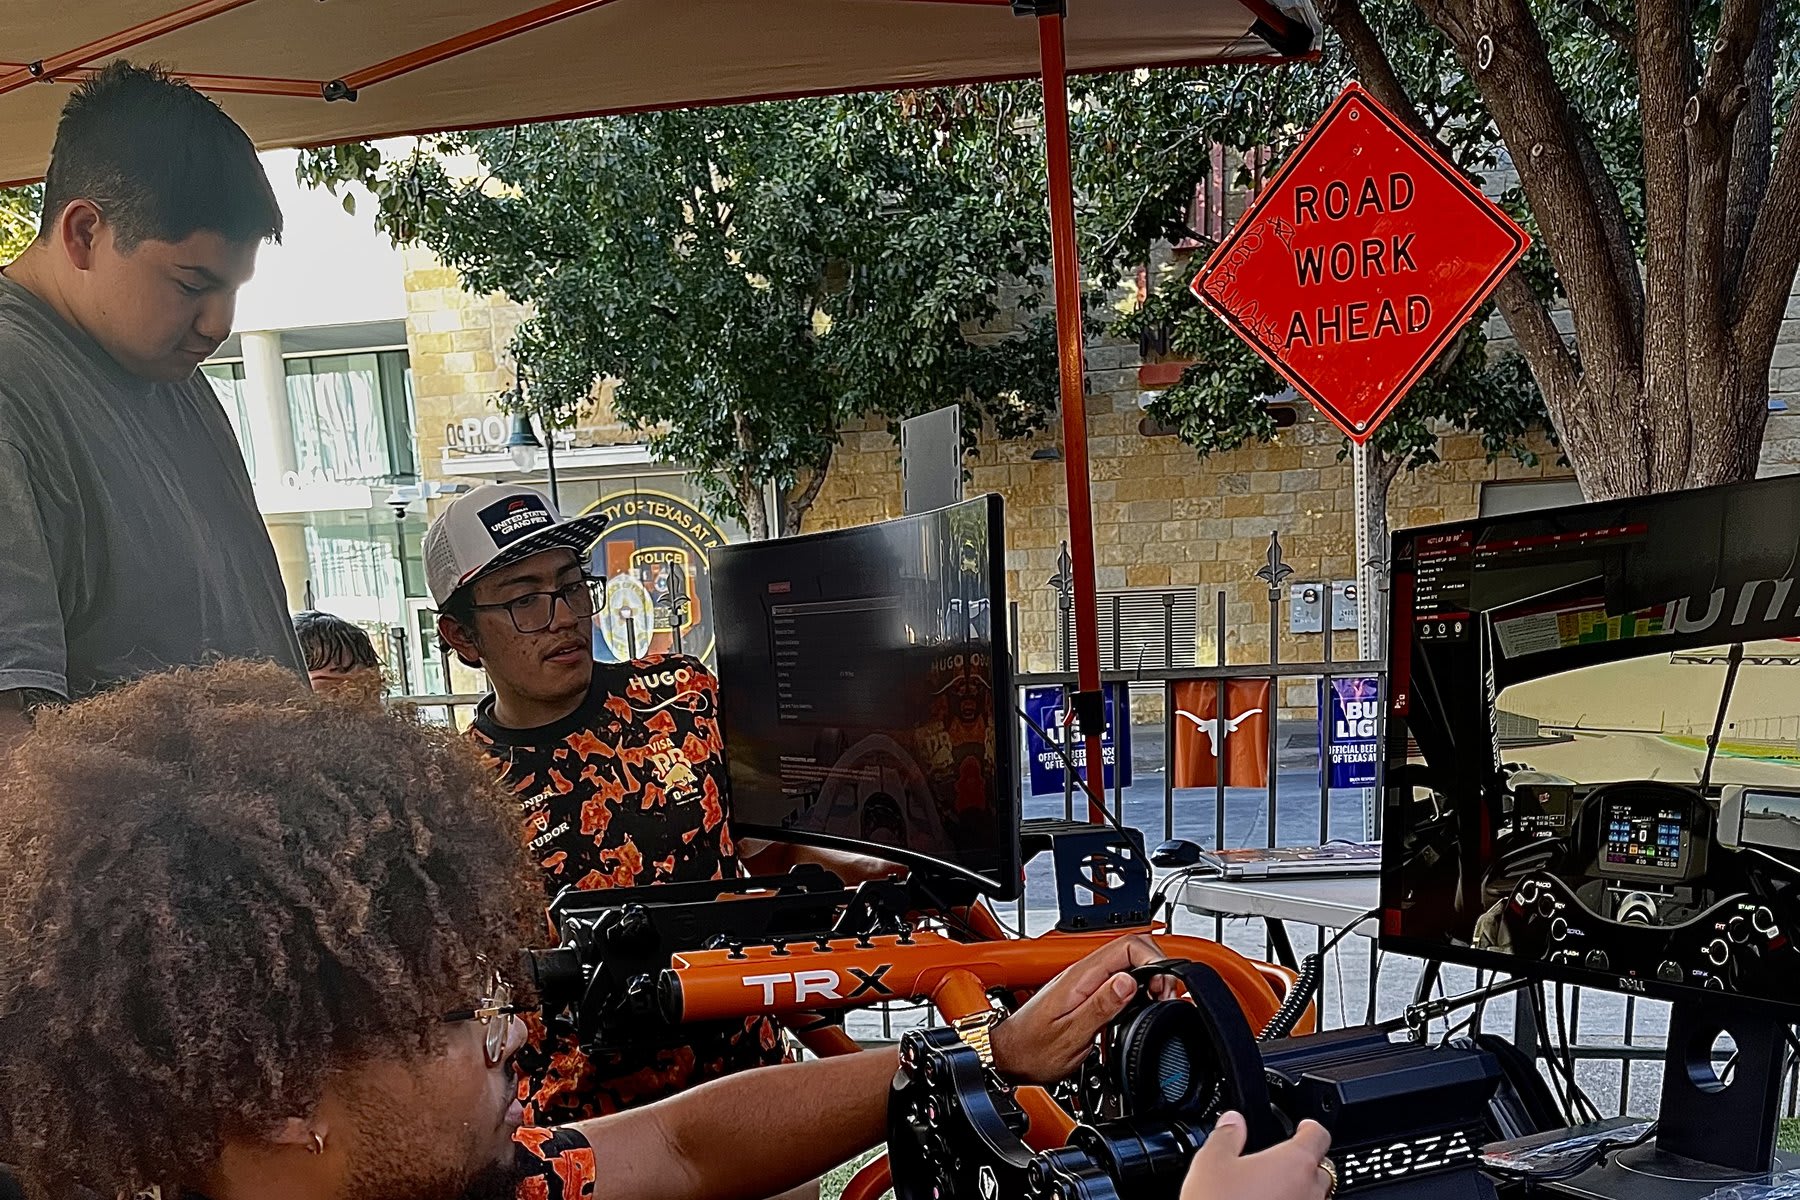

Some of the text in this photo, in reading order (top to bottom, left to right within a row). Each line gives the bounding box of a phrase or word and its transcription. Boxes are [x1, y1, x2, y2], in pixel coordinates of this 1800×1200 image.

[1293, 172, 1415, 225] ROAD
[1295, 234, 1418, 287] WORK
[1285, 295, 1432, 349] AHEAD
[491, 514, 523, 532] UNITED
[522, 510, 548, 520] STATES
[501, 519, 532, 535] GRAND
[646, 500, 693, 529] TEXAS
[689, 522, 711, 541] AT
[636, 552, 683, 566] POLICE
[629, 667, 691, 691] HUGO
[648, 737, 675, 753] VISA
[1329, 744, 1359, 755] FFICIAL
[1333, 754, 1342, 763] OF
[1344, 753, 1367, 763] TEXAS
[519, 784, 556, 811] ONDA
[527, 822, 570, 851] TUDOR
[742, 964, 894, 1005] TRX
[1265, 1073, 1283, 1089] OZA
[1345, 1131, 1475, 1185] MOZA
